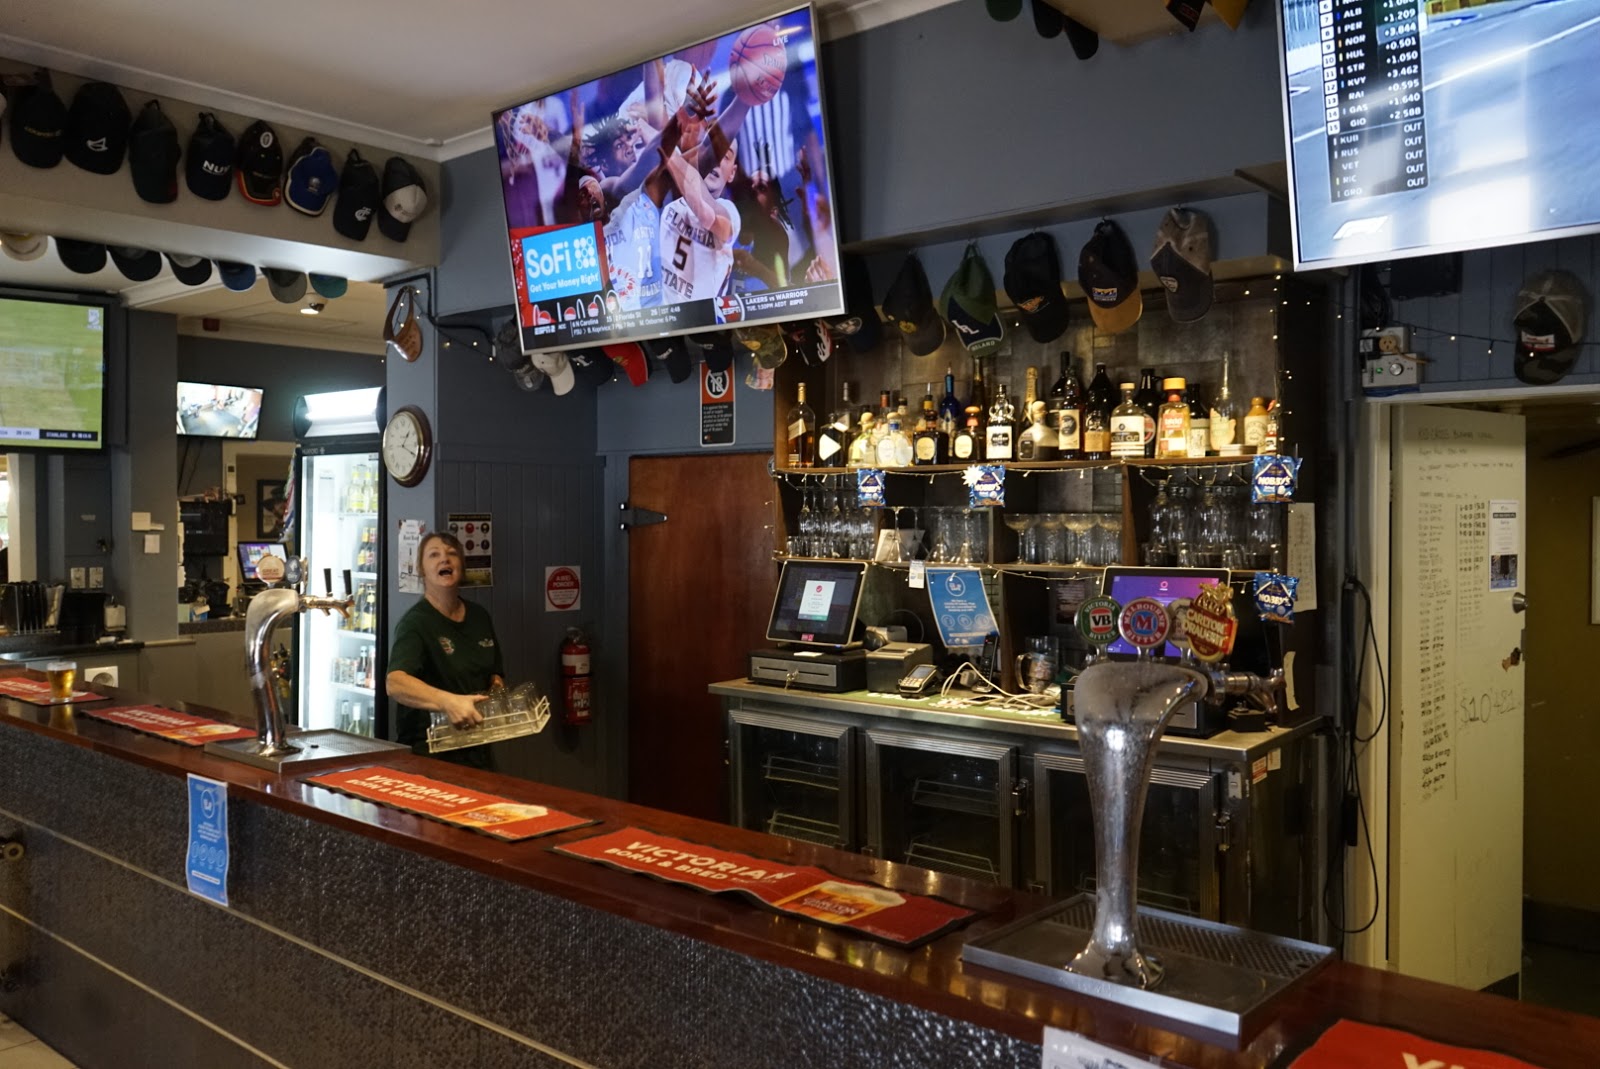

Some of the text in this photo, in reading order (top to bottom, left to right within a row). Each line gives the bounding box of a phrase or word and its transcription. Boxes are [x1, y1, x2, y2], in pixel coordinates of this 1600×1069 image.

[1344, 8, 1362, 18] ALB
[1344, 22, 1362, 32] PER
[772, 35, 788, 46] LIVE
[1345, 35, 1366, 46] NOR
[1346, 49, 1364, 59] HUL
[1347, 62, 1365, 73] STR
[1348, 76, 1366, 86] KVY
[1349, 91, 1364, 100] RAI
[1350, 104, 1368, 114] GAS
[1350, 118, 1366, 127] GIO
[1340, 122, 1422, 144] KUB OUT
[1341, 136, 1422, 157] RUS OUT
[1342, 150, 1423, 170] VET OUT
[1343, 164, 1424, 184] RIC OUT
[1344, 178, 1424, 196] GRO OUT
[666, 207, 716, 249] FLORIDA
[526, 242, 572, 278] SoFi
[672, 235, 692, 271] 5
[530, 273, 598, 293] Get Your Money Right
[661, 265, 693, 299] TATE
[746, 296, 768, 304] LAKERS
[776, 290, 808, 300] WARRIORS
[722, 306, 740, 316] ESPN
[711, 377, 724, 393] 18
[1258, 476, 1291, 486] NOBBY'S
[1085, 601, 1116, 612] VICTORIA
[1124, 602, 1164, 627] MELBOURNE
[1092, 614, 1112, 626] VB
[1136, 615, 1153, 631] M
[1186, 609, 1228, 634] CARLTON
[1089, 631, 1116, 640] BITTER
[1126, 630, 1162, 643] BITTER
[1182, 621, 1228, 647] DRAUGHT
[345, 780, 382, 790] BORN
[389, 790, 426, 800] BRED
[365, 776, 478, 804] VICTORIAN
[604, 848, 658, 863] BORN
[674, 865, 728, 880] BRED
[626, 842, 796, 880] VICTORIAN
